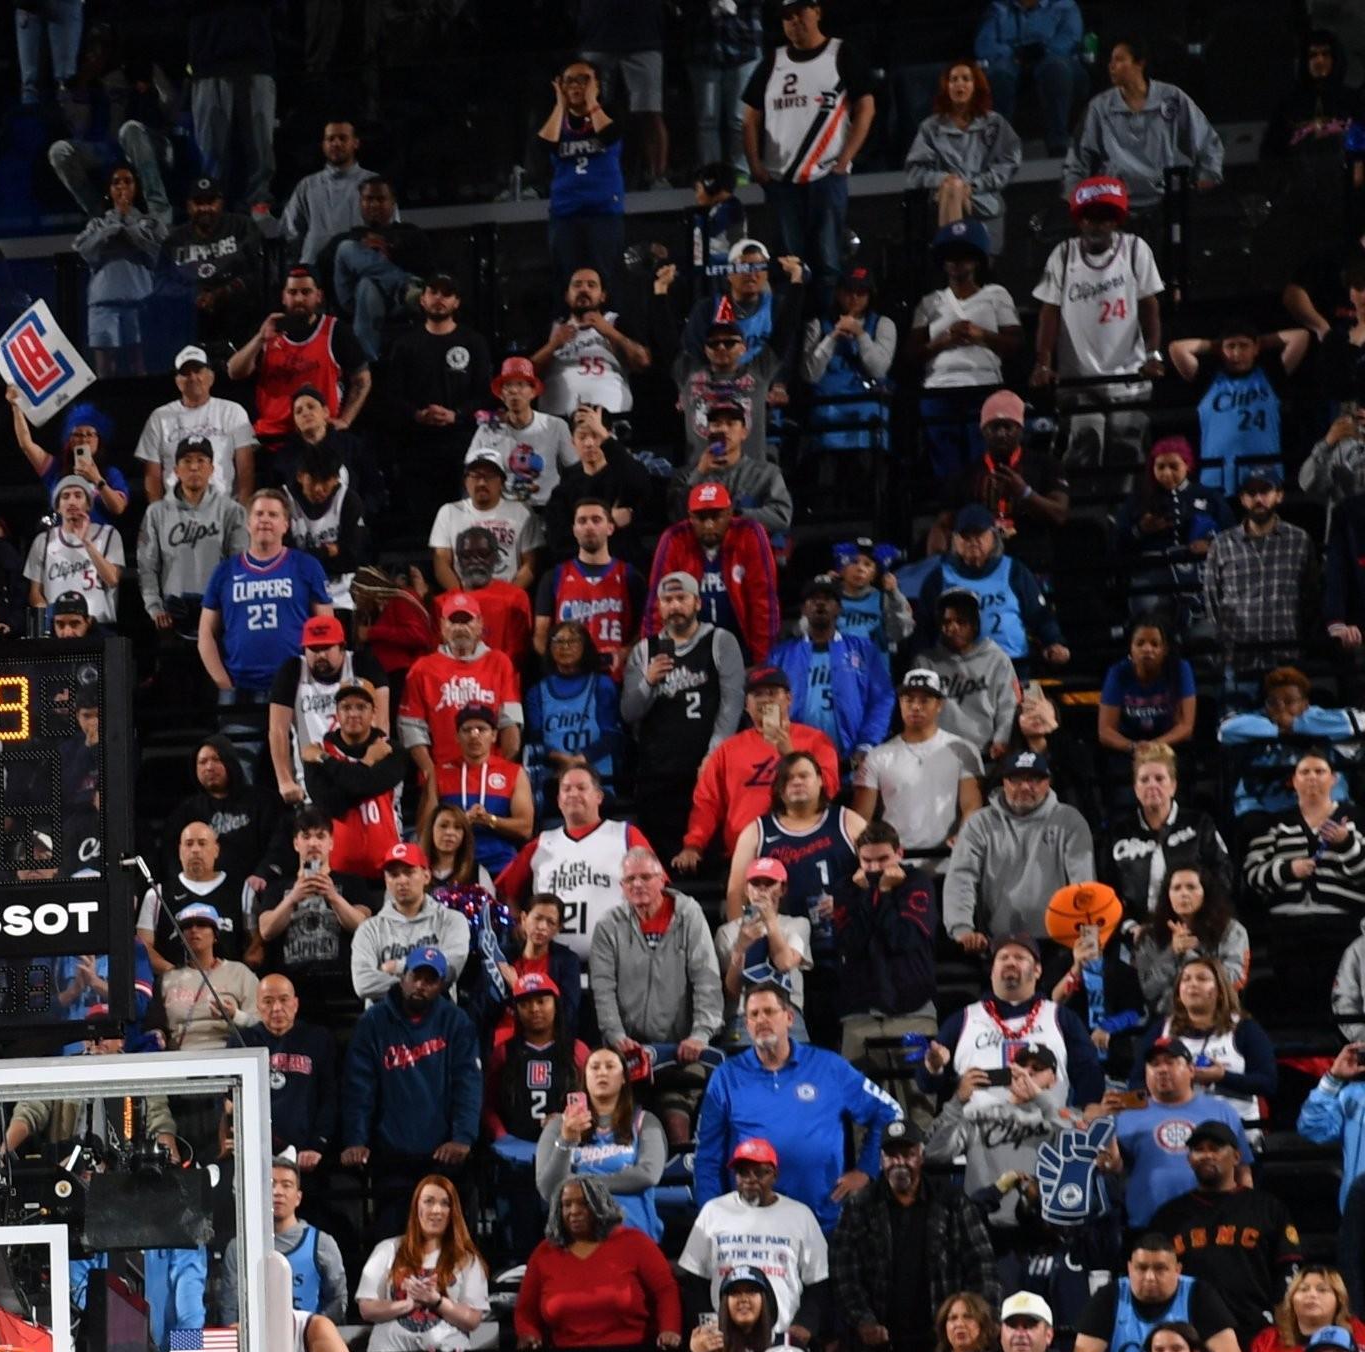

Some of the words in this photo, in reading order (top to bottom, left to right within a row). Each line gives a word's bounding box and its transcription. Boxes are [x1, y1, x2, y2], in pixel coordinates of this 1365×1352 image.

[783, 73, 798, 95] 2
[1099, 299, 1126, 325] 24
[1212, 386, 1268, 414] Clips
[1237, 409, 1268, 432] 24
[167, 520, 220, 550] Clips
[48, 558, 95, 583] Clippe
[231, 578, 293, 603] CLIPPERS
[246, 603, 278, 631] 23
[988, 612, 1002, 634] 2
[685, 691, 702, 719] 2
[815, 860, 828, 886] 1
[529, 1090, 546, 1120] 2
[746, 1235, 761, 1245] THE
[765, 1236, 790, 1247] PAINT
[731, 1250, 748, 1261] THE
[751, 1250, 769, 1261] NET
